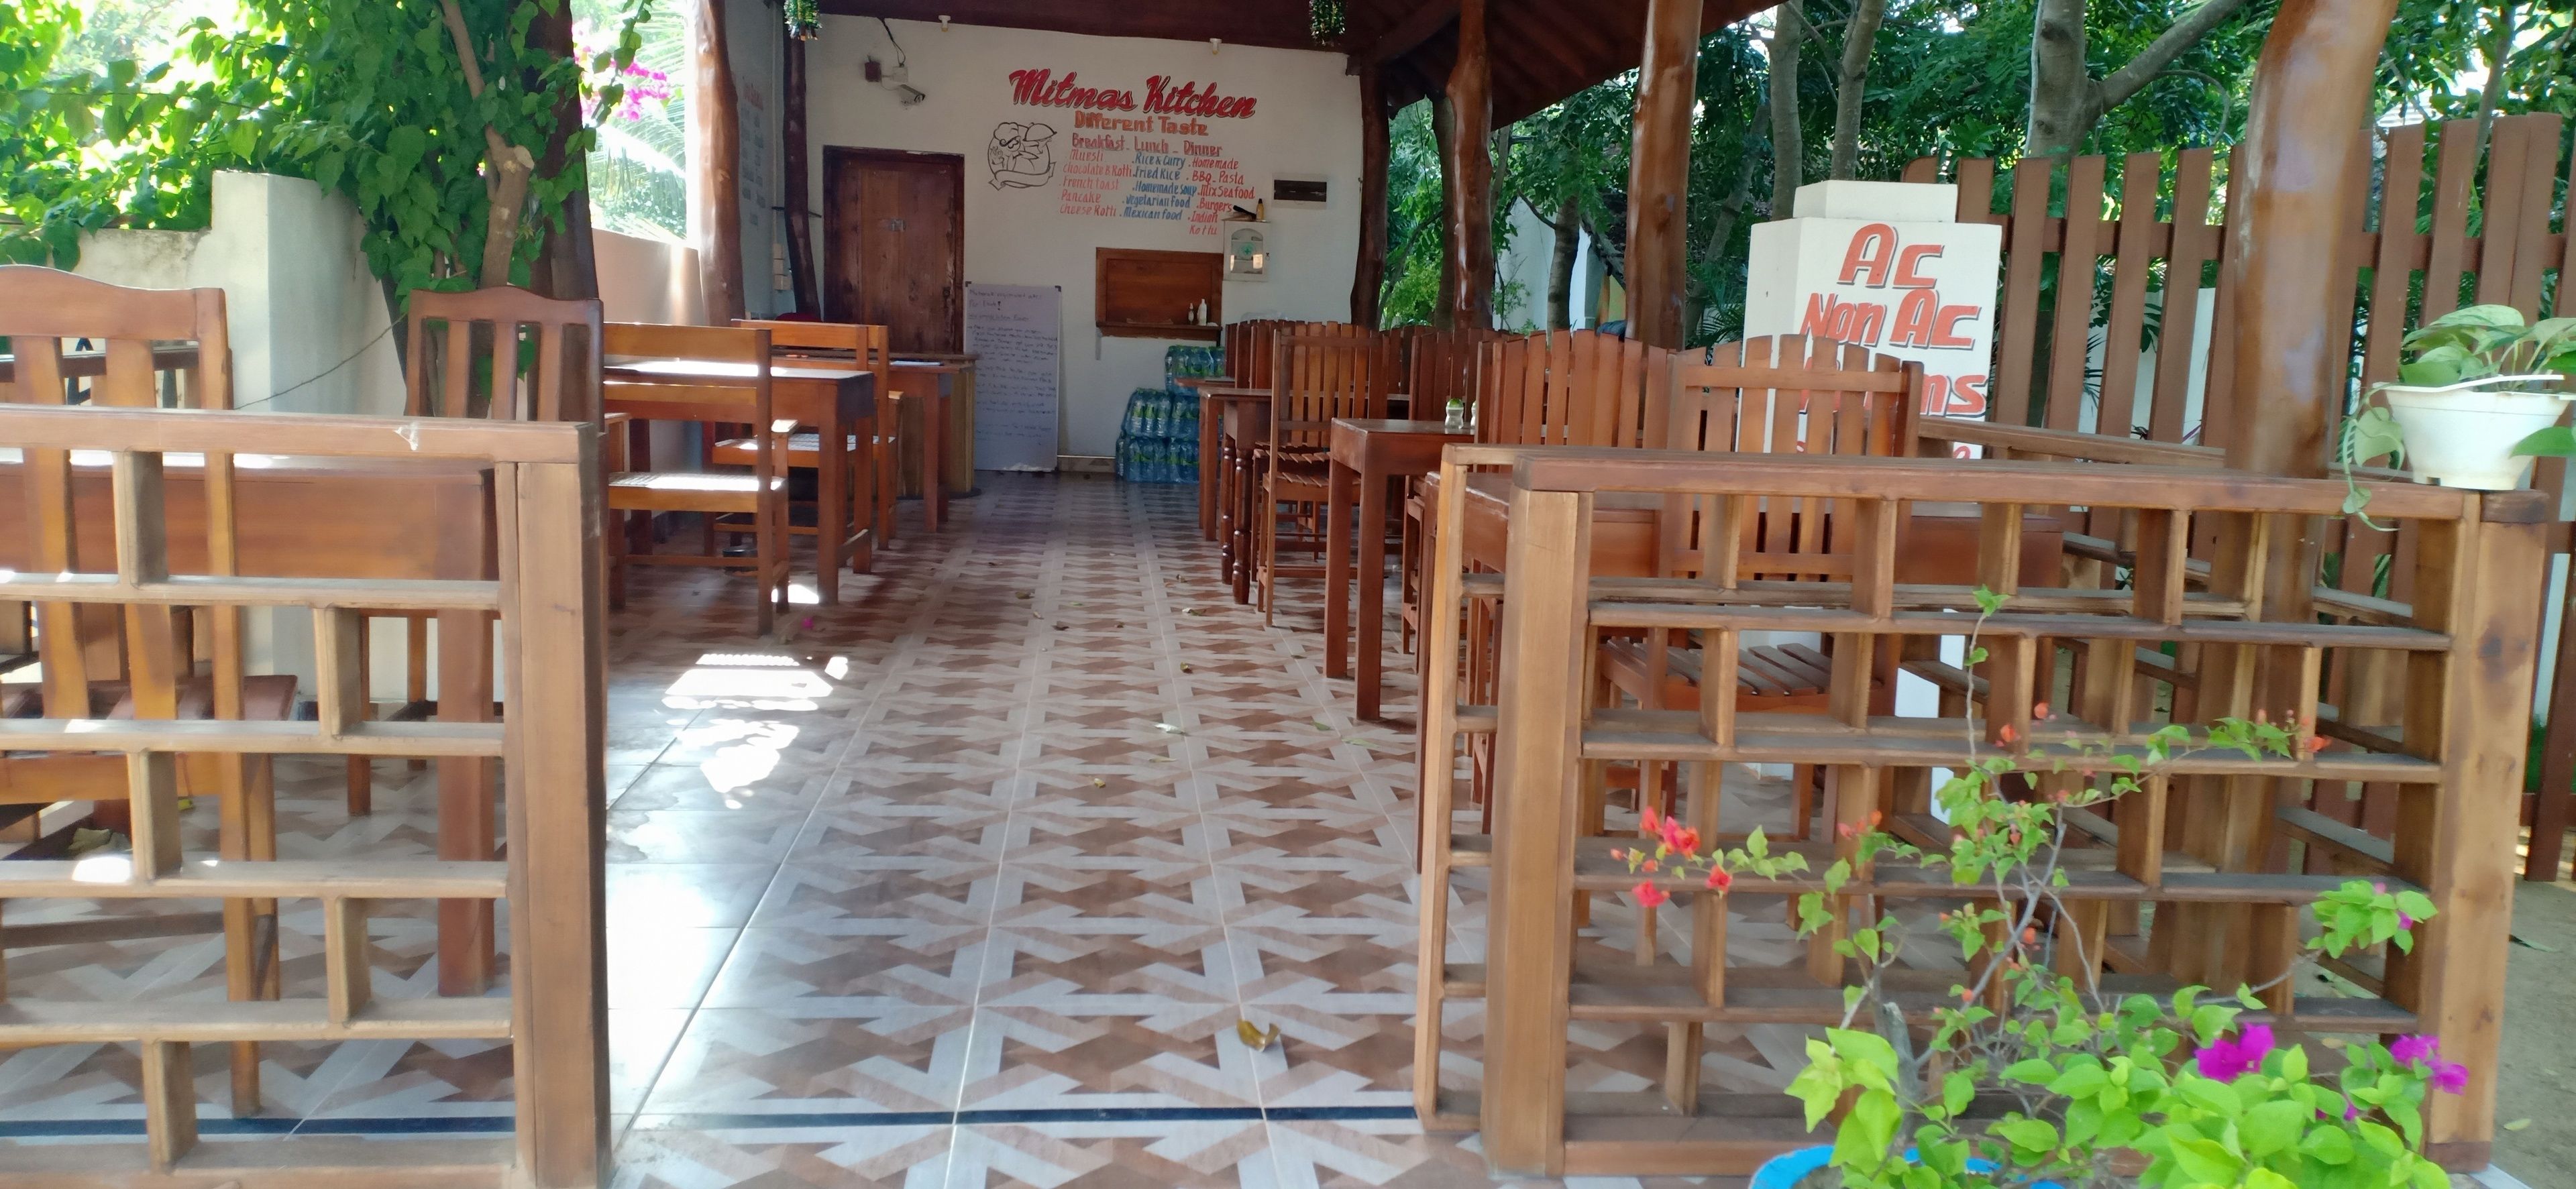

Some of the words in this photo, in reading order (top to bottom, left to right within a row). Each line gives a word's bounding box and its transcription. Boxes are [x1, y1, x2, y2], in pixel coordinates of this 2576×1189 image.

[1009, 68, 1137, 111] Mitmas
[1142, 75, 1256, 118] Kitchen
[1075, 111, 1153, 133] Different
[1159, 116, 1209, 136] Taste
[1073, 133, 1125, 150] Breakfast
[1134, 136, 1169, 154] Lunch
[1183, 140, 1222, 157] Dinner
[1070, 149, 1104, 162] Muesli
[1112, 164, 1132, 178] Rotti
[1192, 158, 1239, 170] Homemade
[1136, 166, 1158, 179] Fried
[1160, 168, 1181, 180] Rice
[1219, 170, 1244, 185] Pasta
[1063, 176, 1093, 189] French
[1135, 180, 1179, 194] Homemade
[1061, 188, 1101, 203] Pancake
[1218, 186, 1255, 199] Seafood
[1094, 205, 1116, 217] Rotti
[1124, 207, 1161, 219] Mexican
[1199, 198, 1232, 214] Burgers
[1191, 211, 1218, 223] Indian
[1800, 292, 1887, 347] Non
